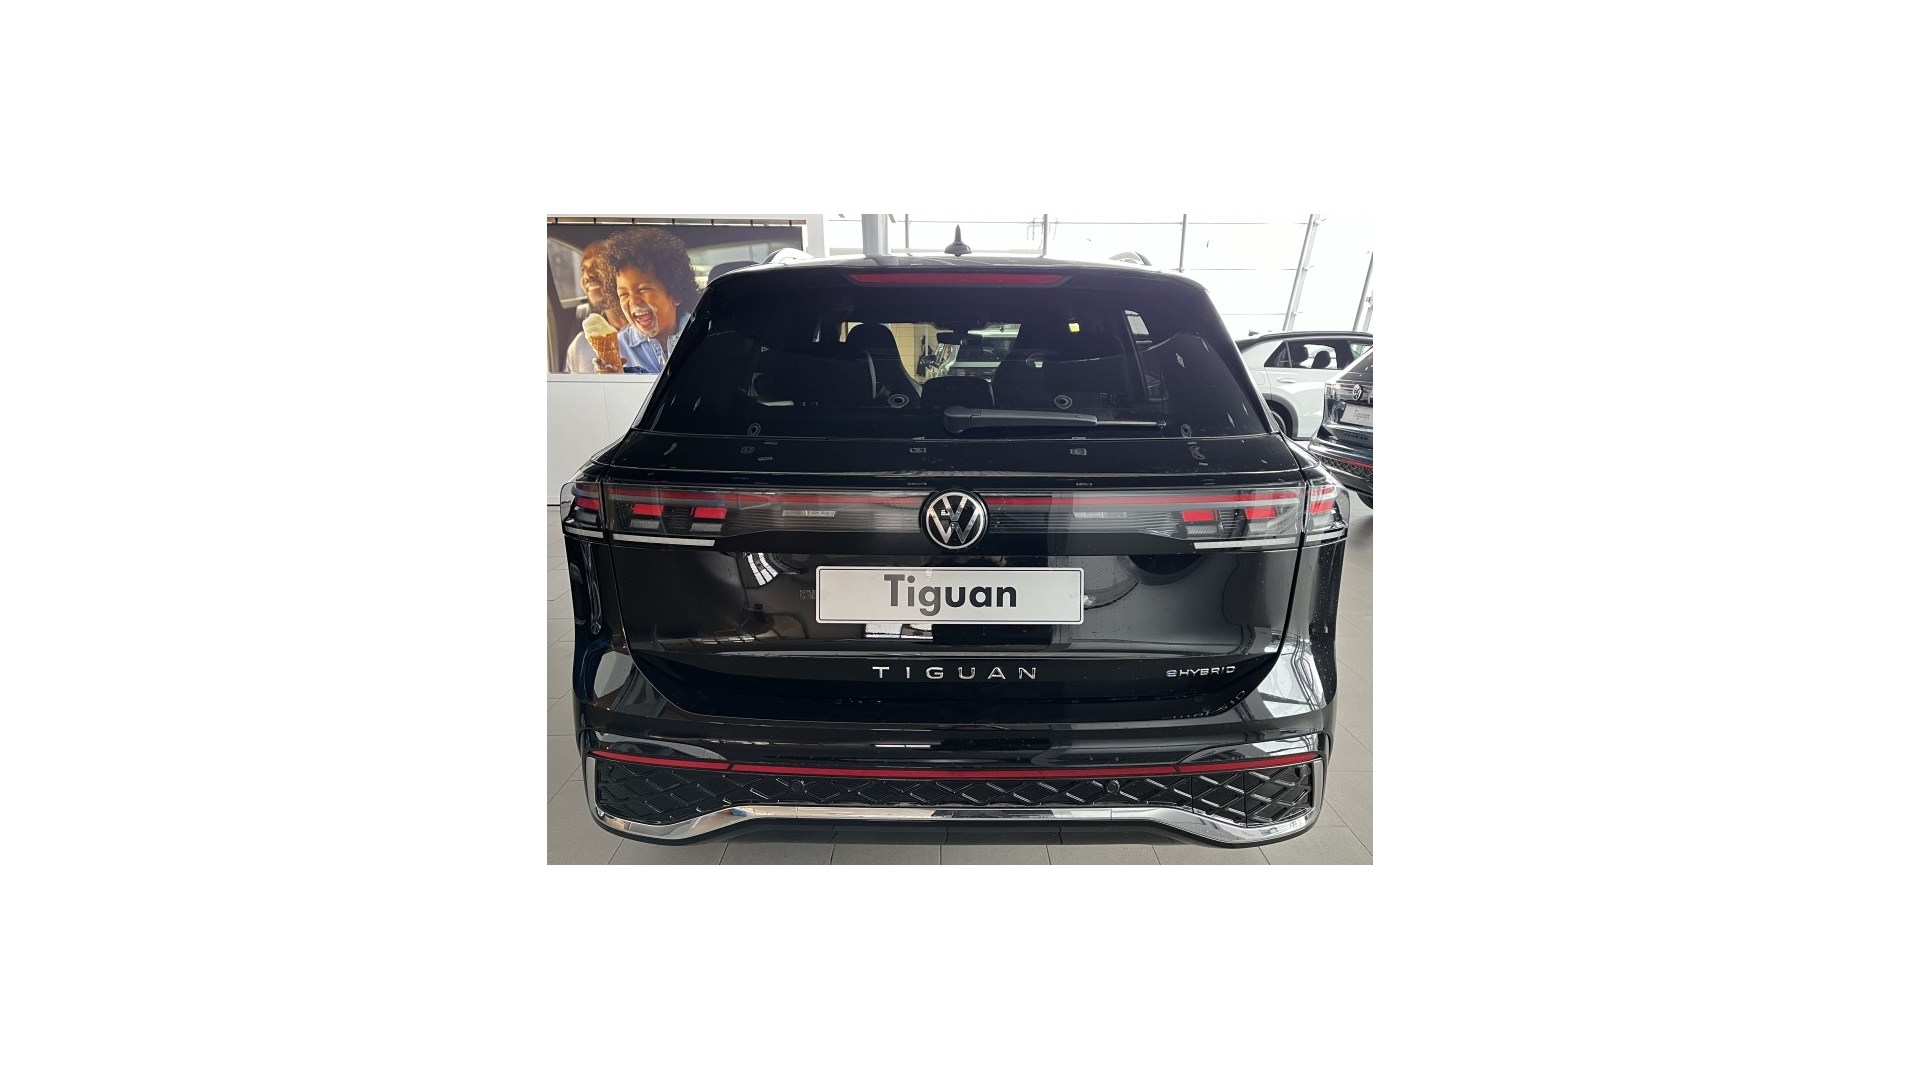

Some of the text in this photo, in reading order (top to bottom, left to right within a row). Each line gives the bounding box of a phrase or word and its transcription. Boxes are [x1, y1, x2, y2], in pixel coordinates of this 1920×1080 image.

[883, 574, 1017, 616] Tiguan
[872, 666, 1037, 680] TIGUAN
[1166, 665, 1236, 678] eHYBRID
